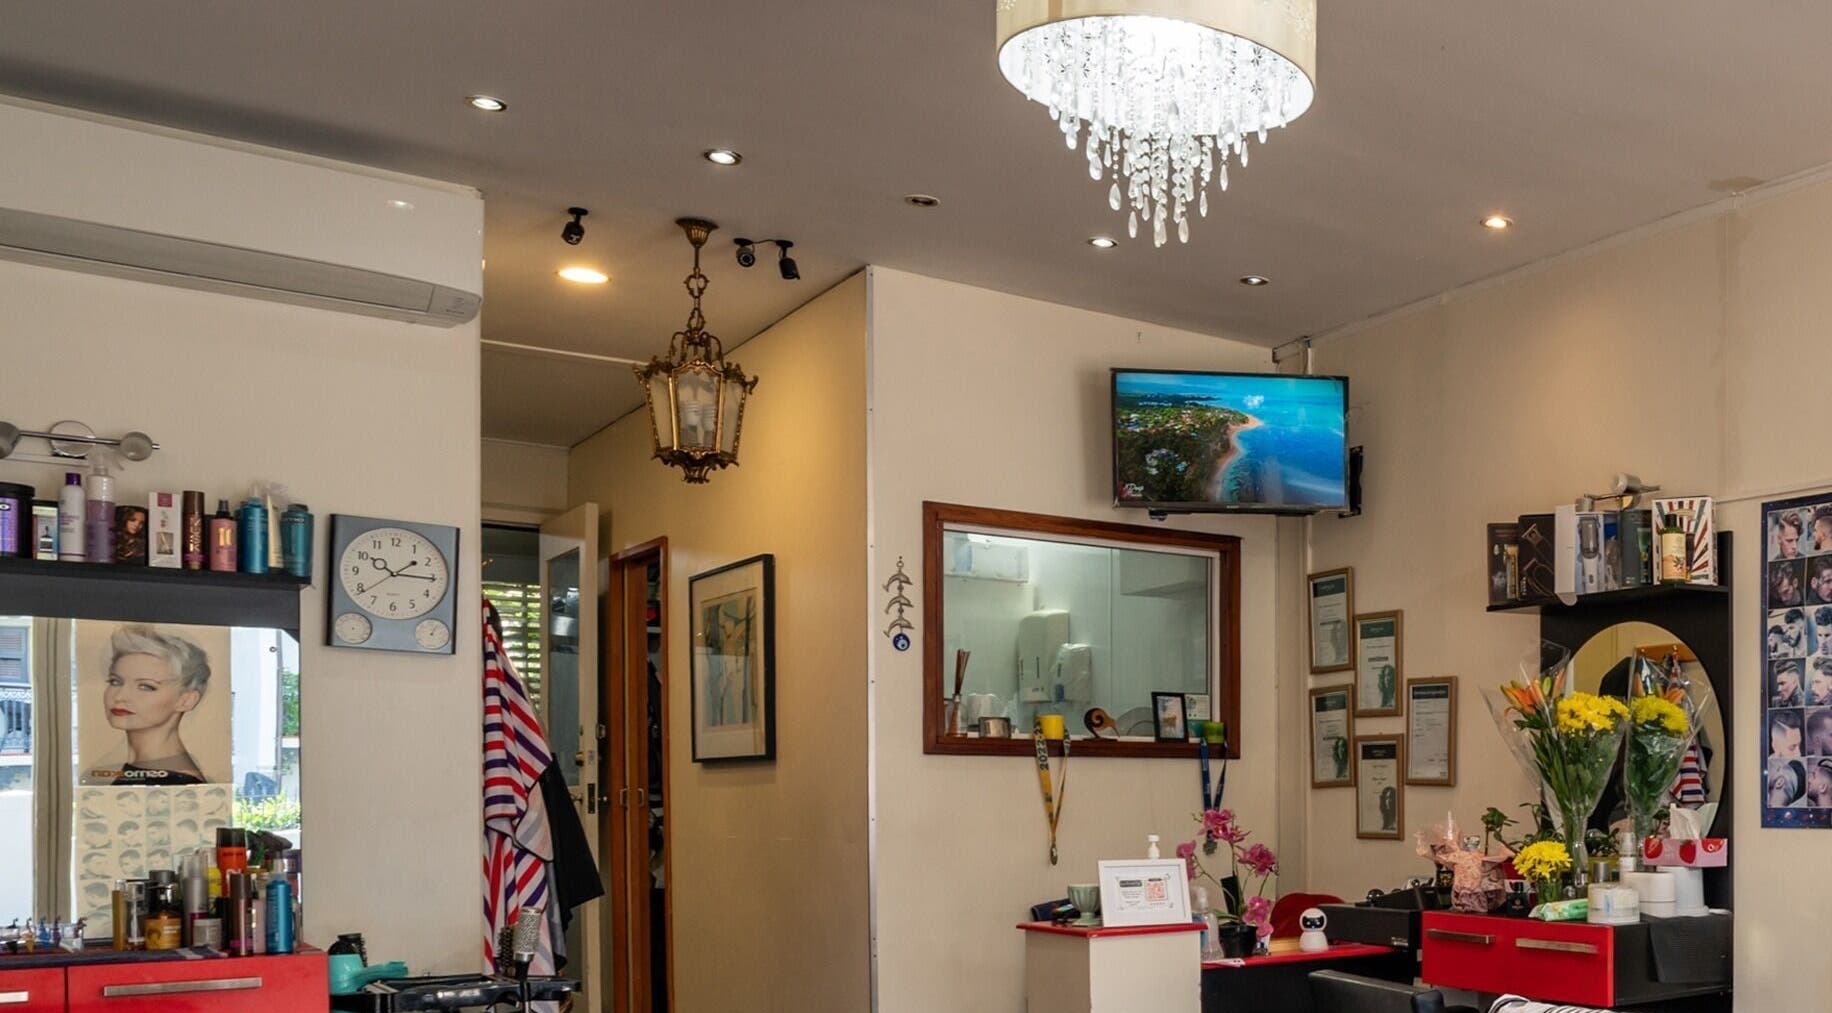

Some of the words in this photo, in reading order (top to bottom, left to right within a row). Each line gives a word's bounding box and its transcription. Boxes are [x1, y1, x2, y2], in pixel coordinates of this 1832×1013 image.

[372, 540, 382, 549] 11
[391, 538, 401, 547] 12
[412, 544, 416, 554] 1
[358, 551, 368, 560] 10
[424, 557, 432, 567] 2
[352, 566, 359, 575] 9
[423, 590, 430, 598] 4
[370, 596, 378, 604] 7
[409, 600, 416, 609] 5
[389, 602, 397, 611] 6
